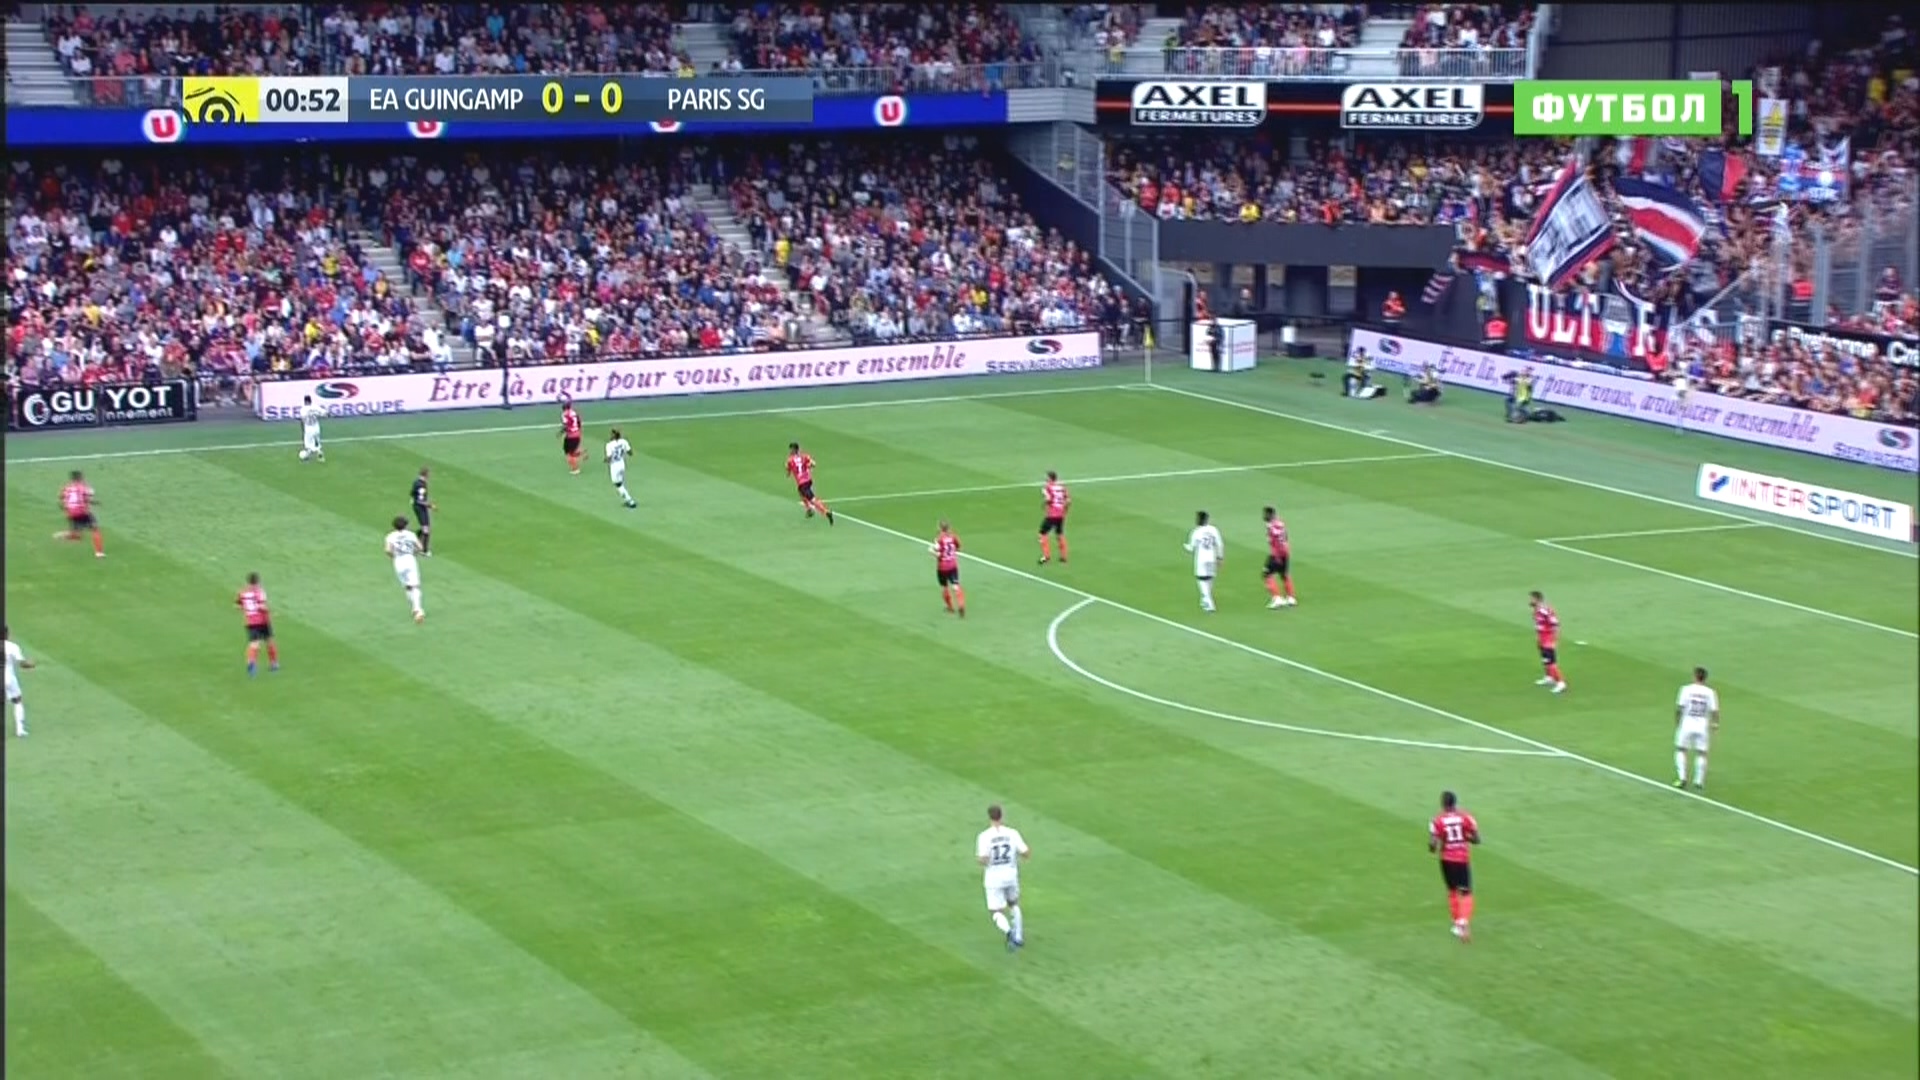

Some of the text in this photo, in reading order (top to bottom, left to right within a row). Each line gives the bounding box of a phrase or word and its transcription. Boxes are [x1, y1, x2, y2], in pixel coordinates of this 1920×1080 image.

[1140, 84, 1258, 107] AXEL
[1353, 87, 1476, 110] AXEL
[1137, 110, 1259, 124] FERMETURES
[1349, 112, 1478, 127] FERMETURES
[429, 375, 491, 402] Être
[541, 372, 600, 403] agir
[604, 370, 667, 400] pour
[673, 365, 741, 388] vous,
[747, 361, 852, 383] avancer
[856, 345, 967, 376] ensemble
[985, 355, 1101, 374] SERVAGROUPE
[1731, 475, 1897, 530] INTERSPORT
[991, 843, 1011, 861] 12
